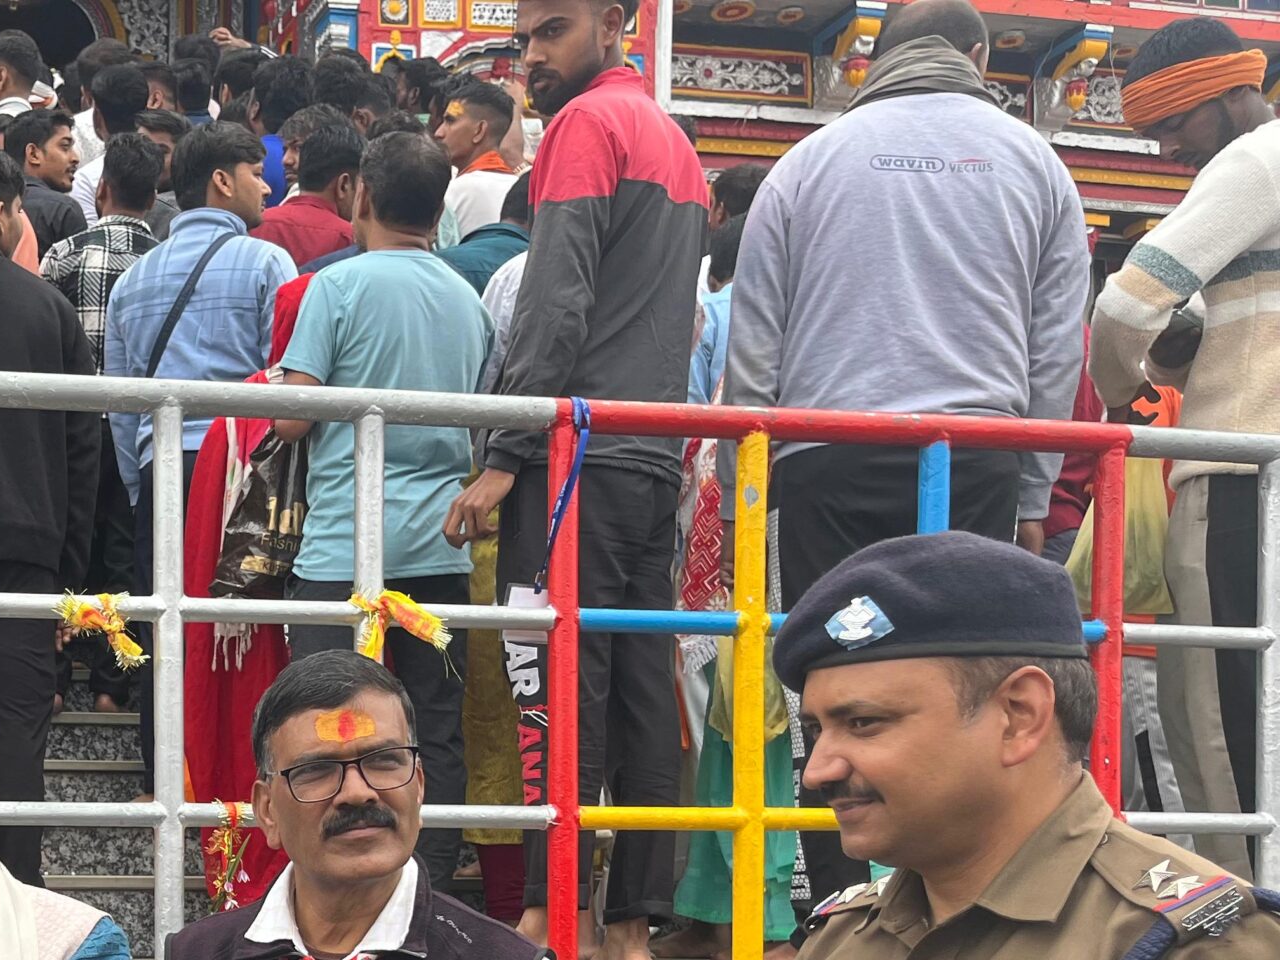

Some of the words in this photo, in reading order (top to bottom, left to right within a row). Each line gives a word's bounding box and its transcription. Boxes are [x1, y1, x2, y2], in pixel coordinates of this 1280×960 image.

[877, 156, 938, 171] wavin
[949, 162, 994, 173] VECTUS
[261, 532, 298, 552] Fashi
